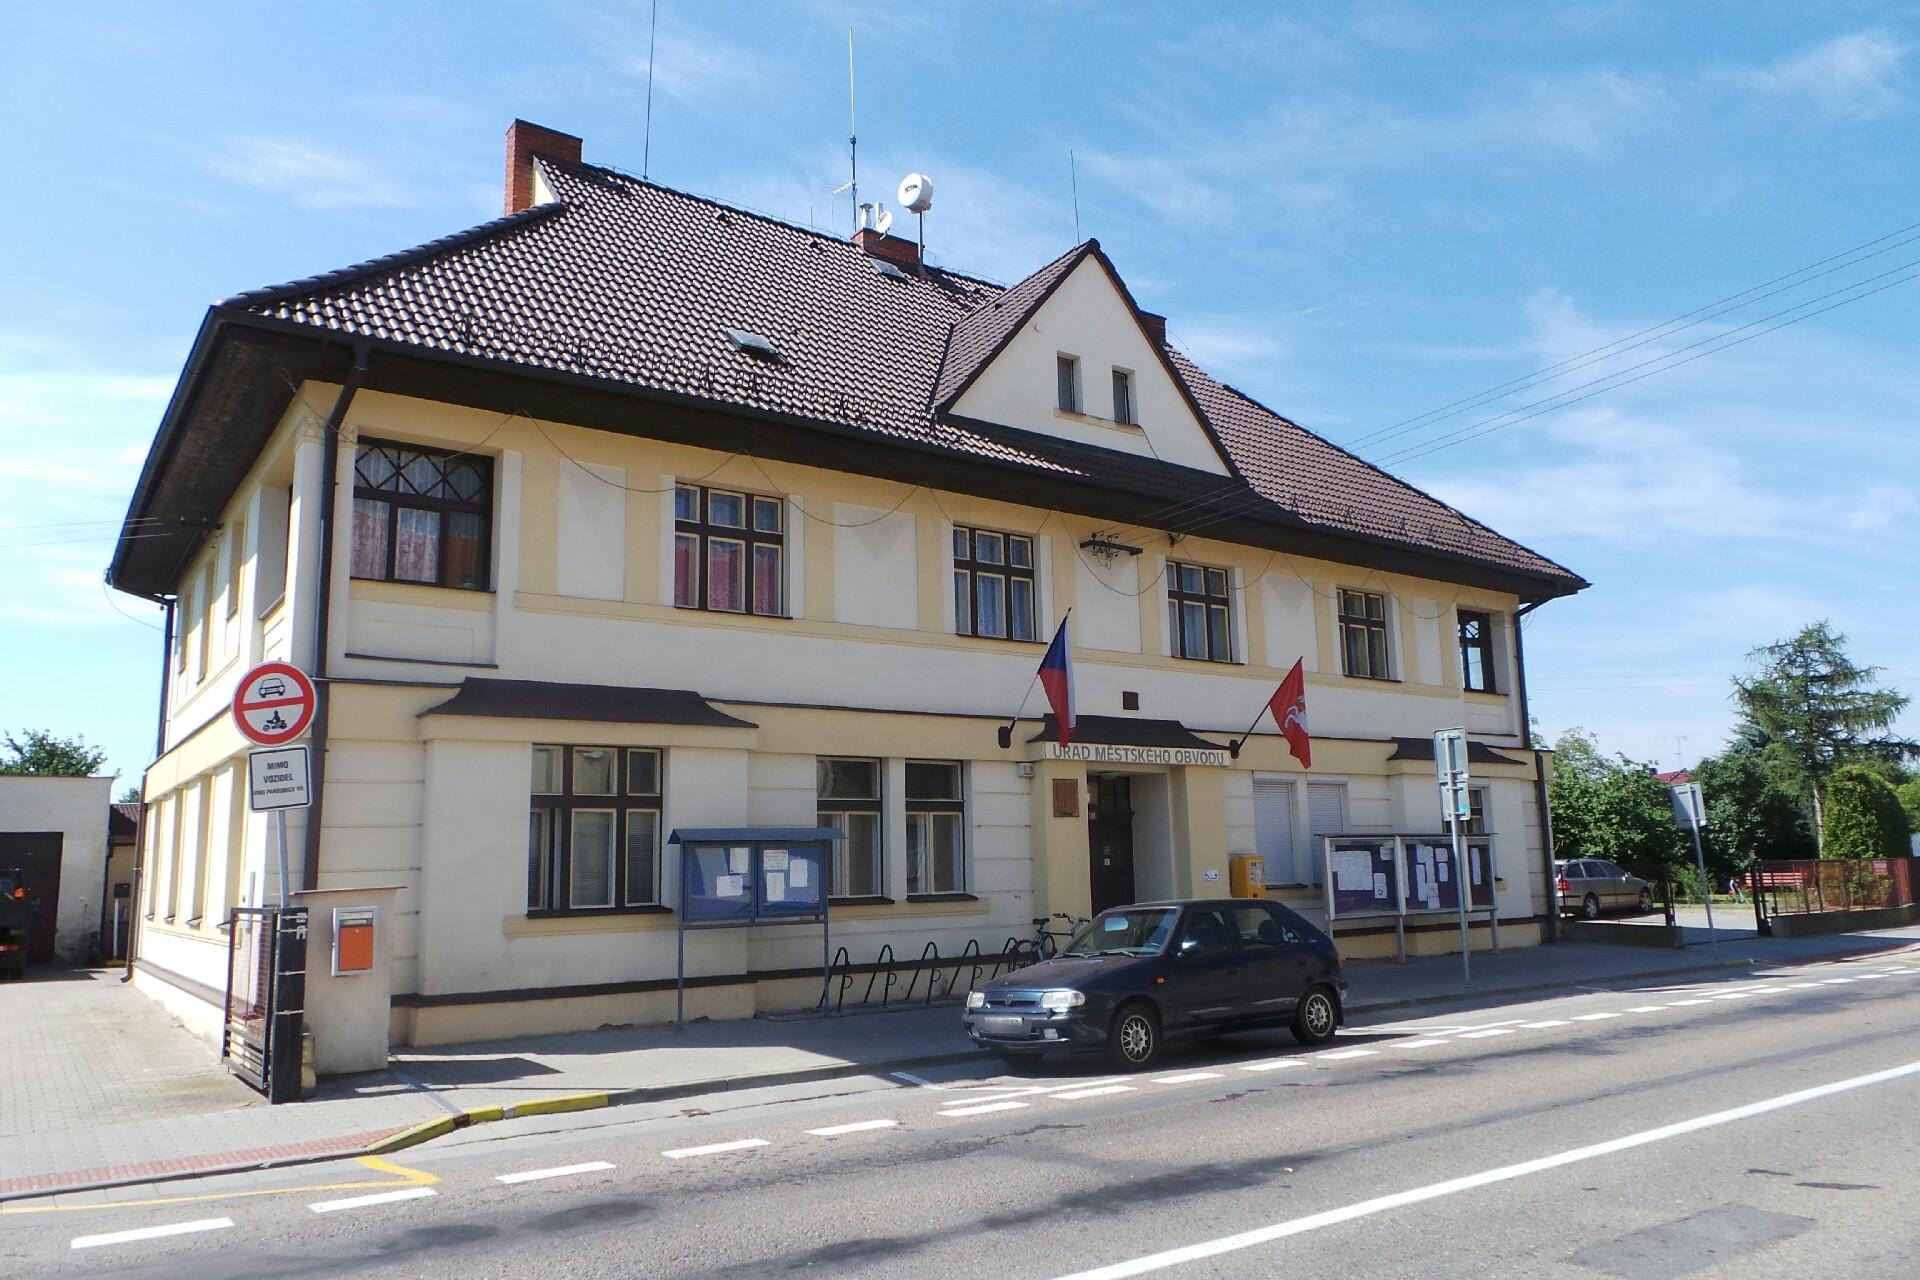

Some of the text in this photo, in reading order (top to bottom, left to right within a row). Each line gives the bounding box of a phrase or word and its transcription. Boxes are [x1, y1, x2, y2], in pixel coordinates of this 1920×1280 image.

[1174, 749, 1224, 765] OBVODU
[267, 761, 289, 770] MIMO
[263, 773, 294, 784] VOZIDEL
